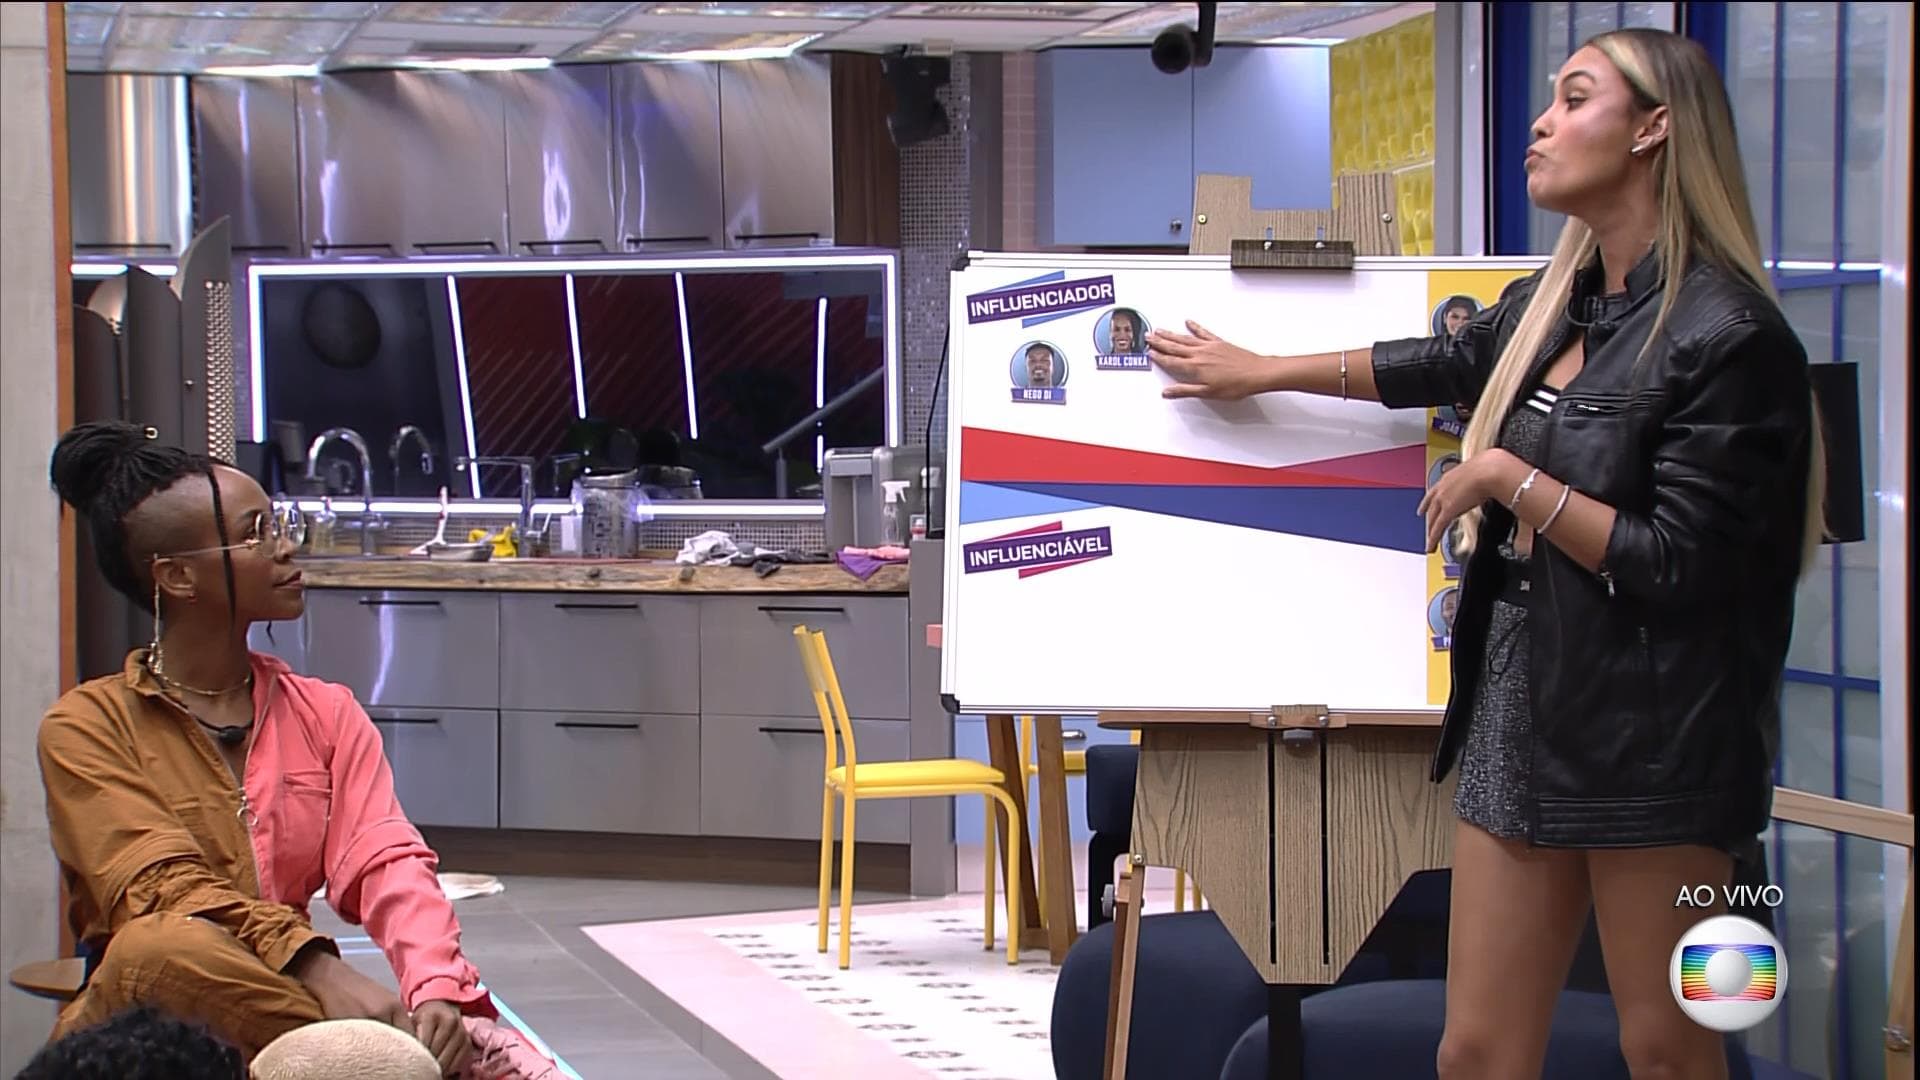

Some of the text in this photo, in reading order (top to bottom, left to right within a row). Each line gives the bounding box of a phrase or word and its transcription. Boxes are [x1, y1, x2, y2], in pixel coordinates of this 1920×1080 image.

[970, 283, 1113, 317] INFLUENCIADOR
[1098, 355, 1121, 366] KAROL
[1023, 388, 1052, 400] NEGO DI
[969, 536, 1108, 567] INFLUENCIÁVEL
